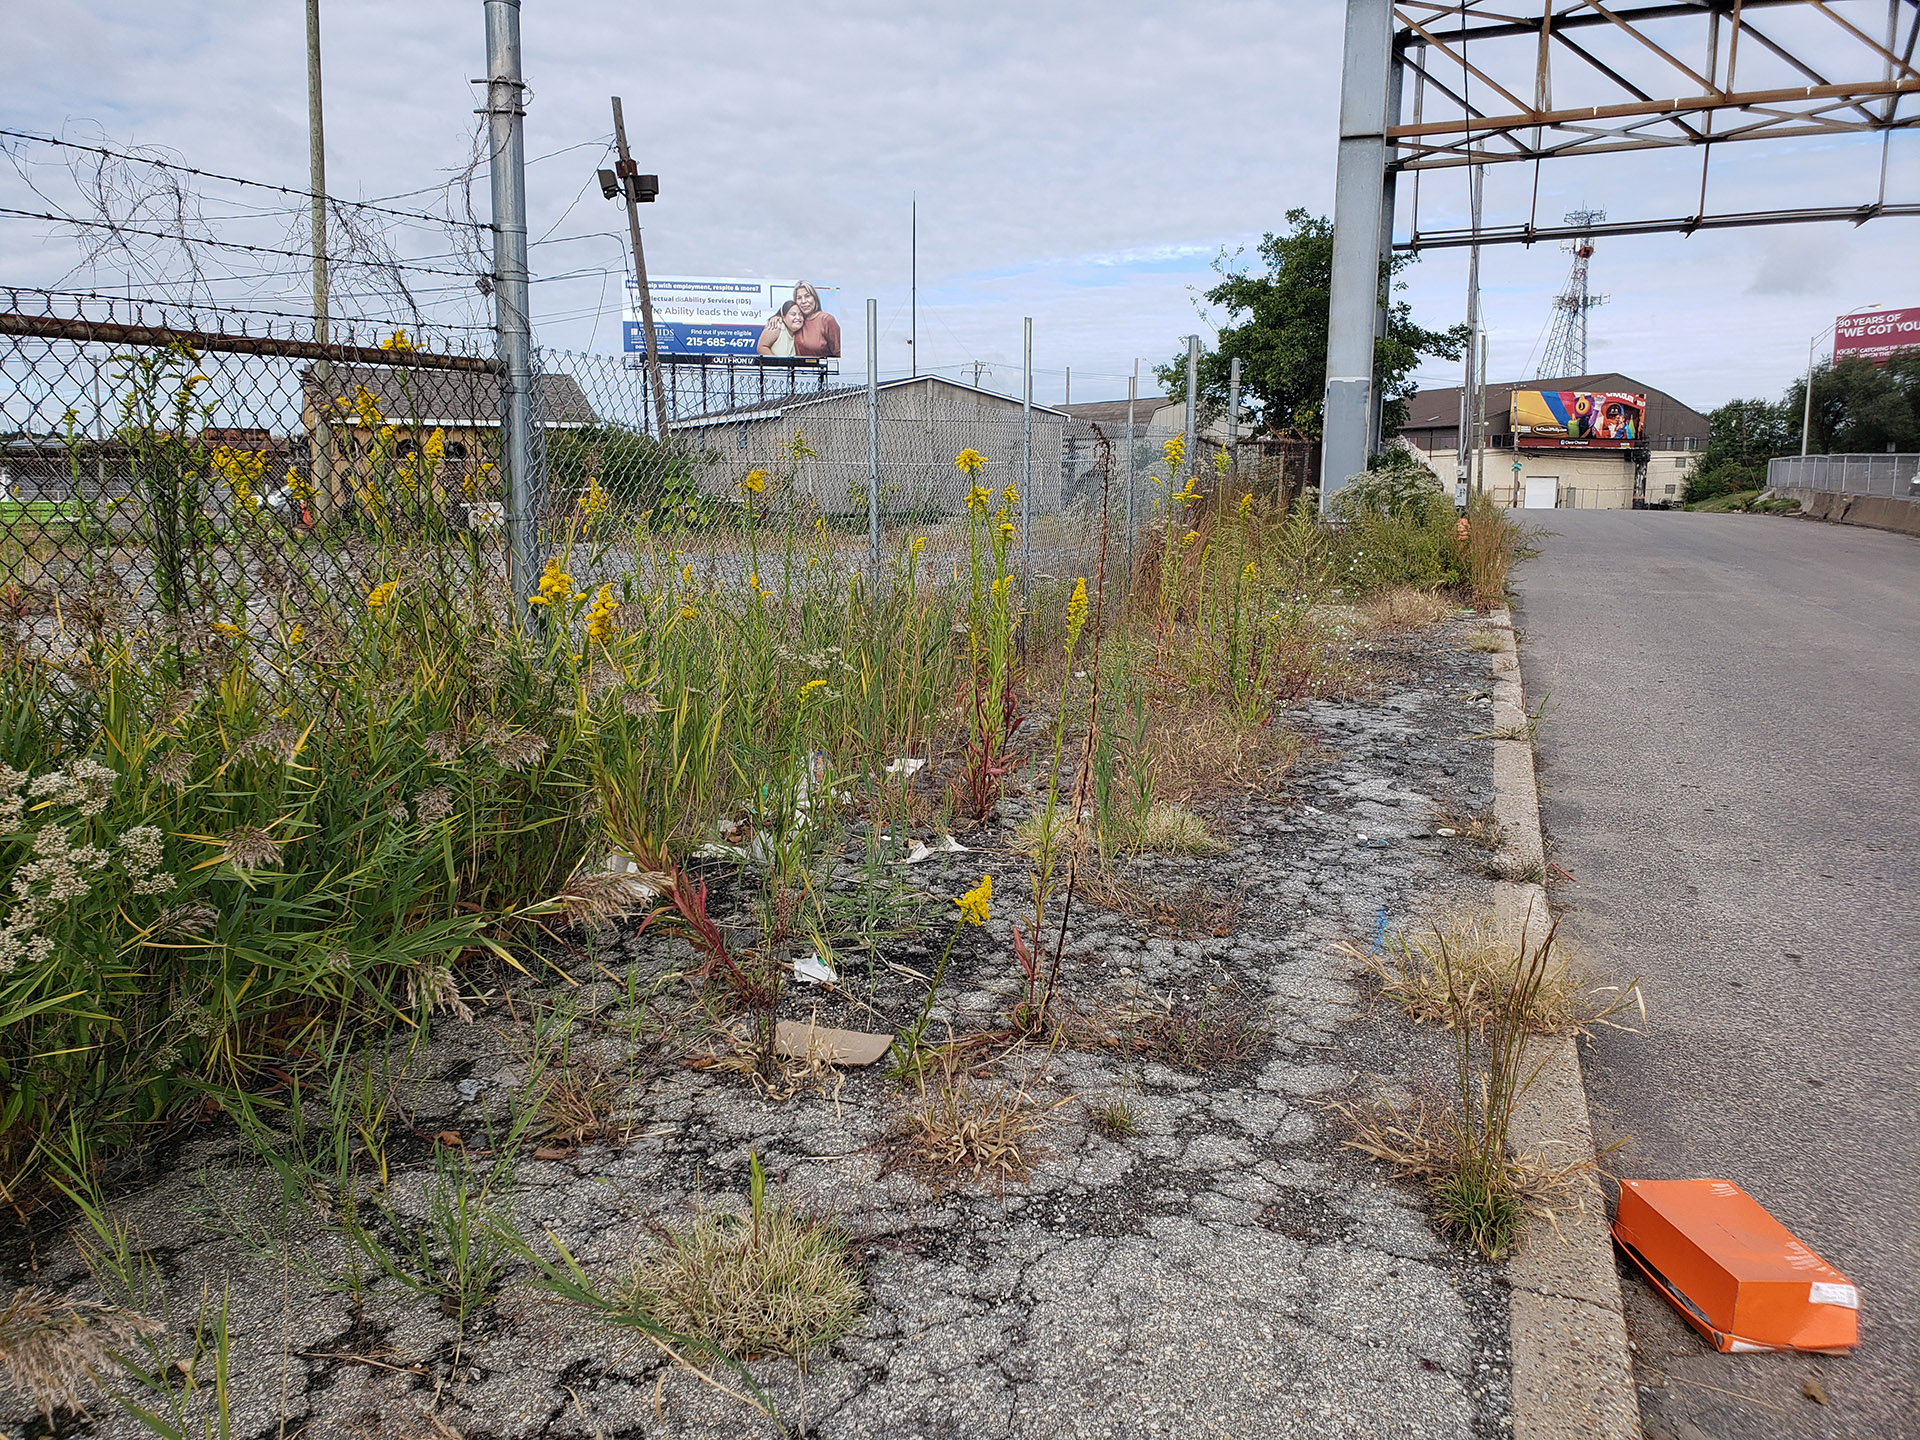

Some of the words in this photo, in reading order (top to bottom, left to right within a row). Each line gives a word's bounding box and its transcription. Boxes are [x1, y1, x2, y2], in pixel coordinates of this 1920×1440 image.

[664, 307, 694, 316] Ability
[740, 310, 762, 318] way!
[1852, 316, 1885, 326] YEARS
[1886, 314, 1902, 322] OF
[1867, 324, 1894, 335] GOT
[686, 336, 756, 348] 215-685-4677
